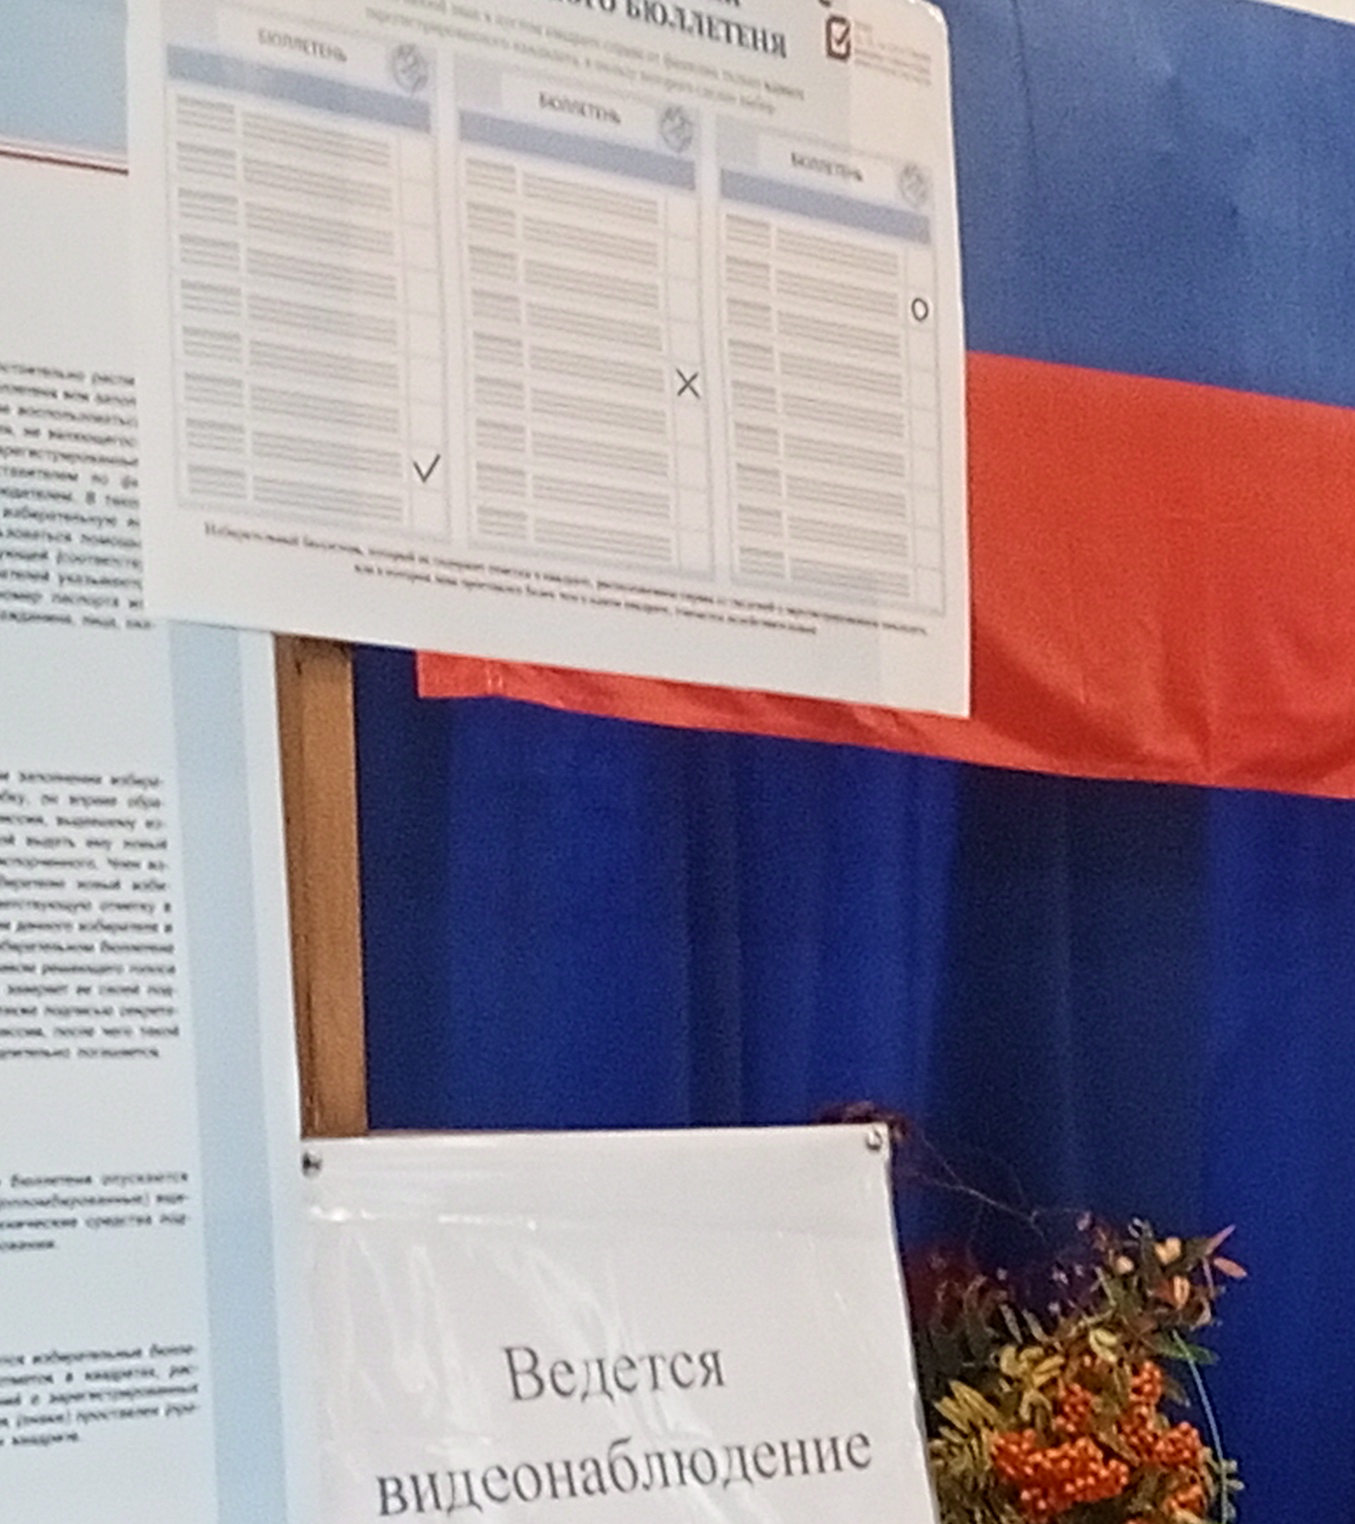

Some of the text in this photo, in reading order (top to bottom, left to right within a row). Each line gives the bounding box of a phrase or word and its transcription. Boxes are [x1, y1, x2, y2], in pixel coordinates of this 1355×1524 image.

[627, 0, 788, 58] БЮЛЛЕТЕНЯ
[502, 1344, 727, 1404] Ведется
[374, 1430, 874, 1519] видеонаблюдение
